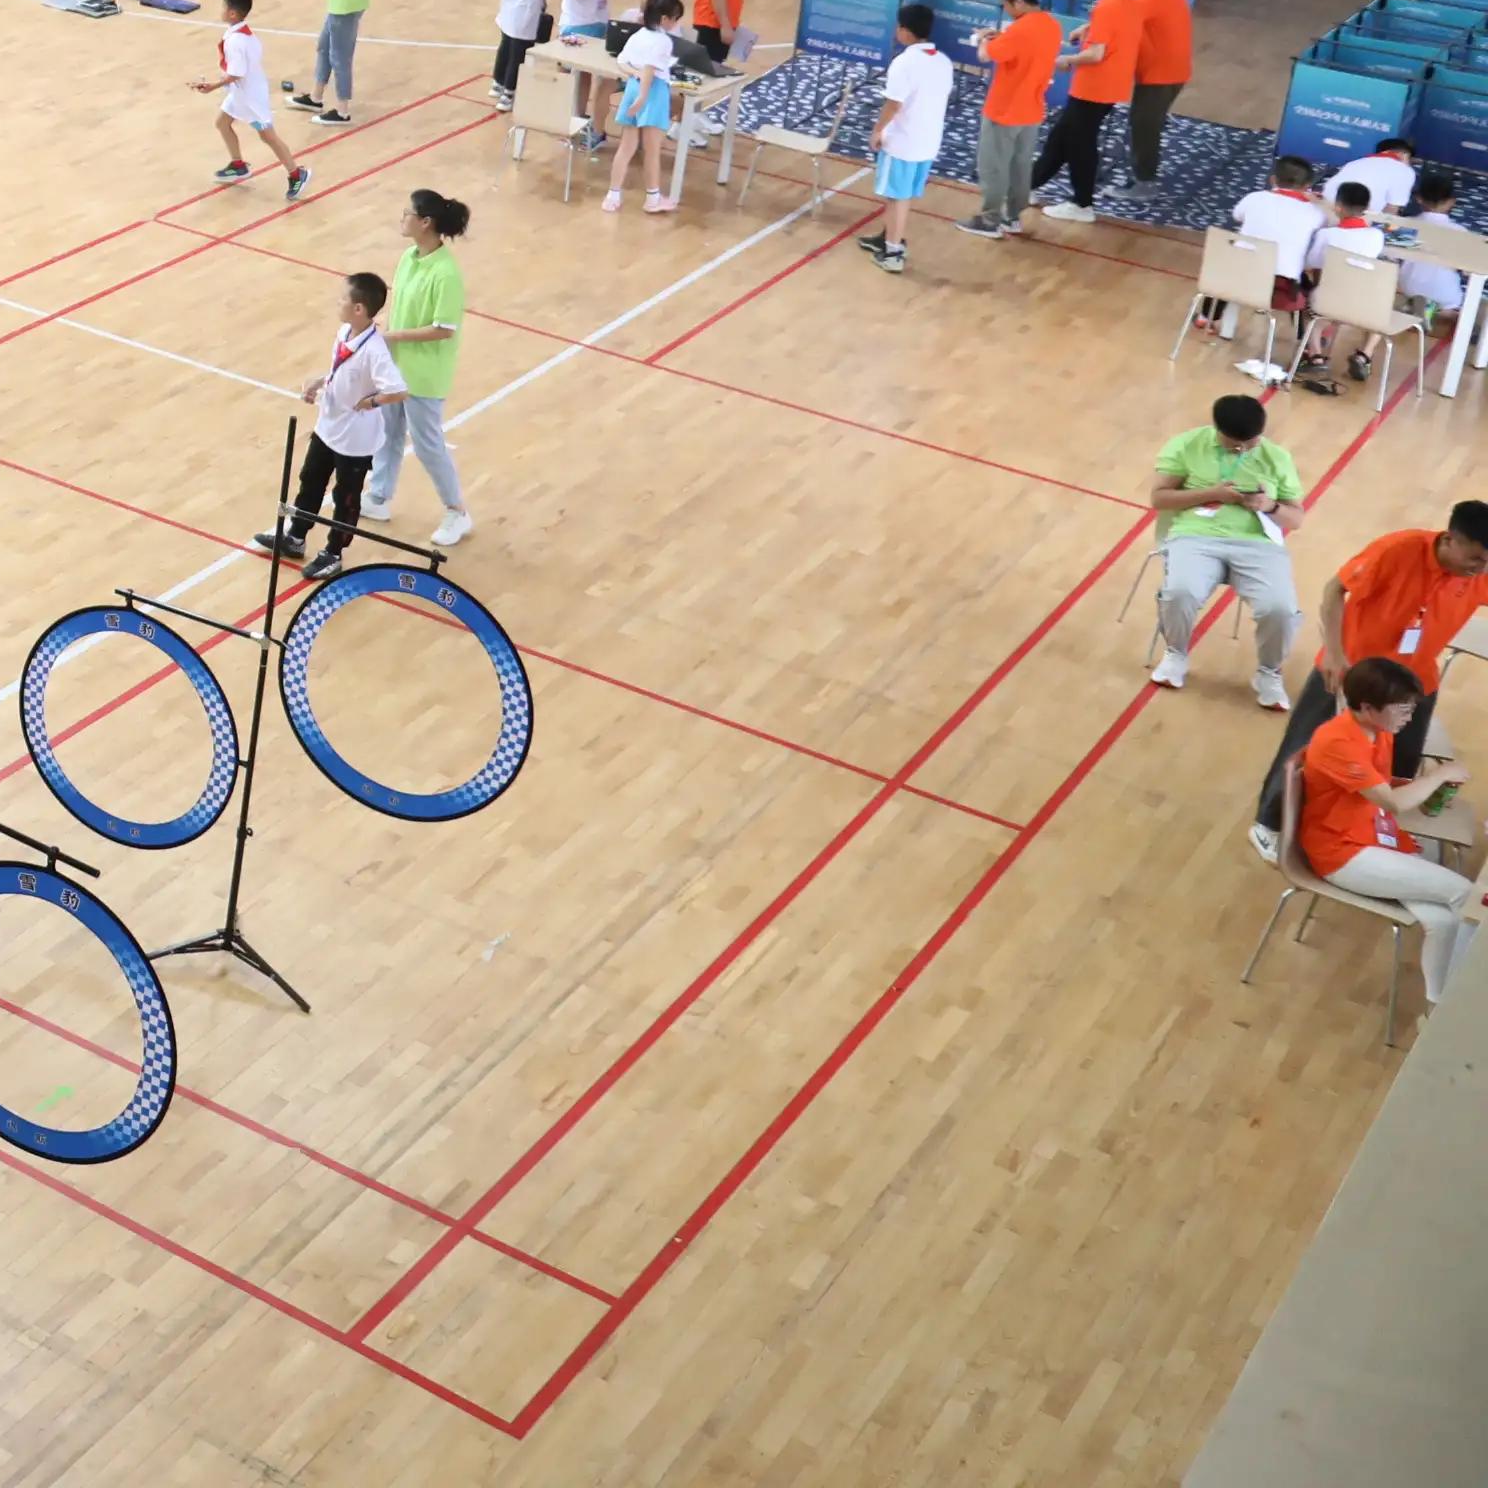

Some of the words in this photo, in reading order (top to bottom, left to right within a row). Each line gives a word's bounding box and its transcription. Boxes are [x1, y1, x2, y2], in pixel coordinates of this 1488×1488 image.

[398, 572, 457, 608] 雪豹
[103, 613, 156, 640] 雪豹
[17, 872, 81, 911] 雪豹
